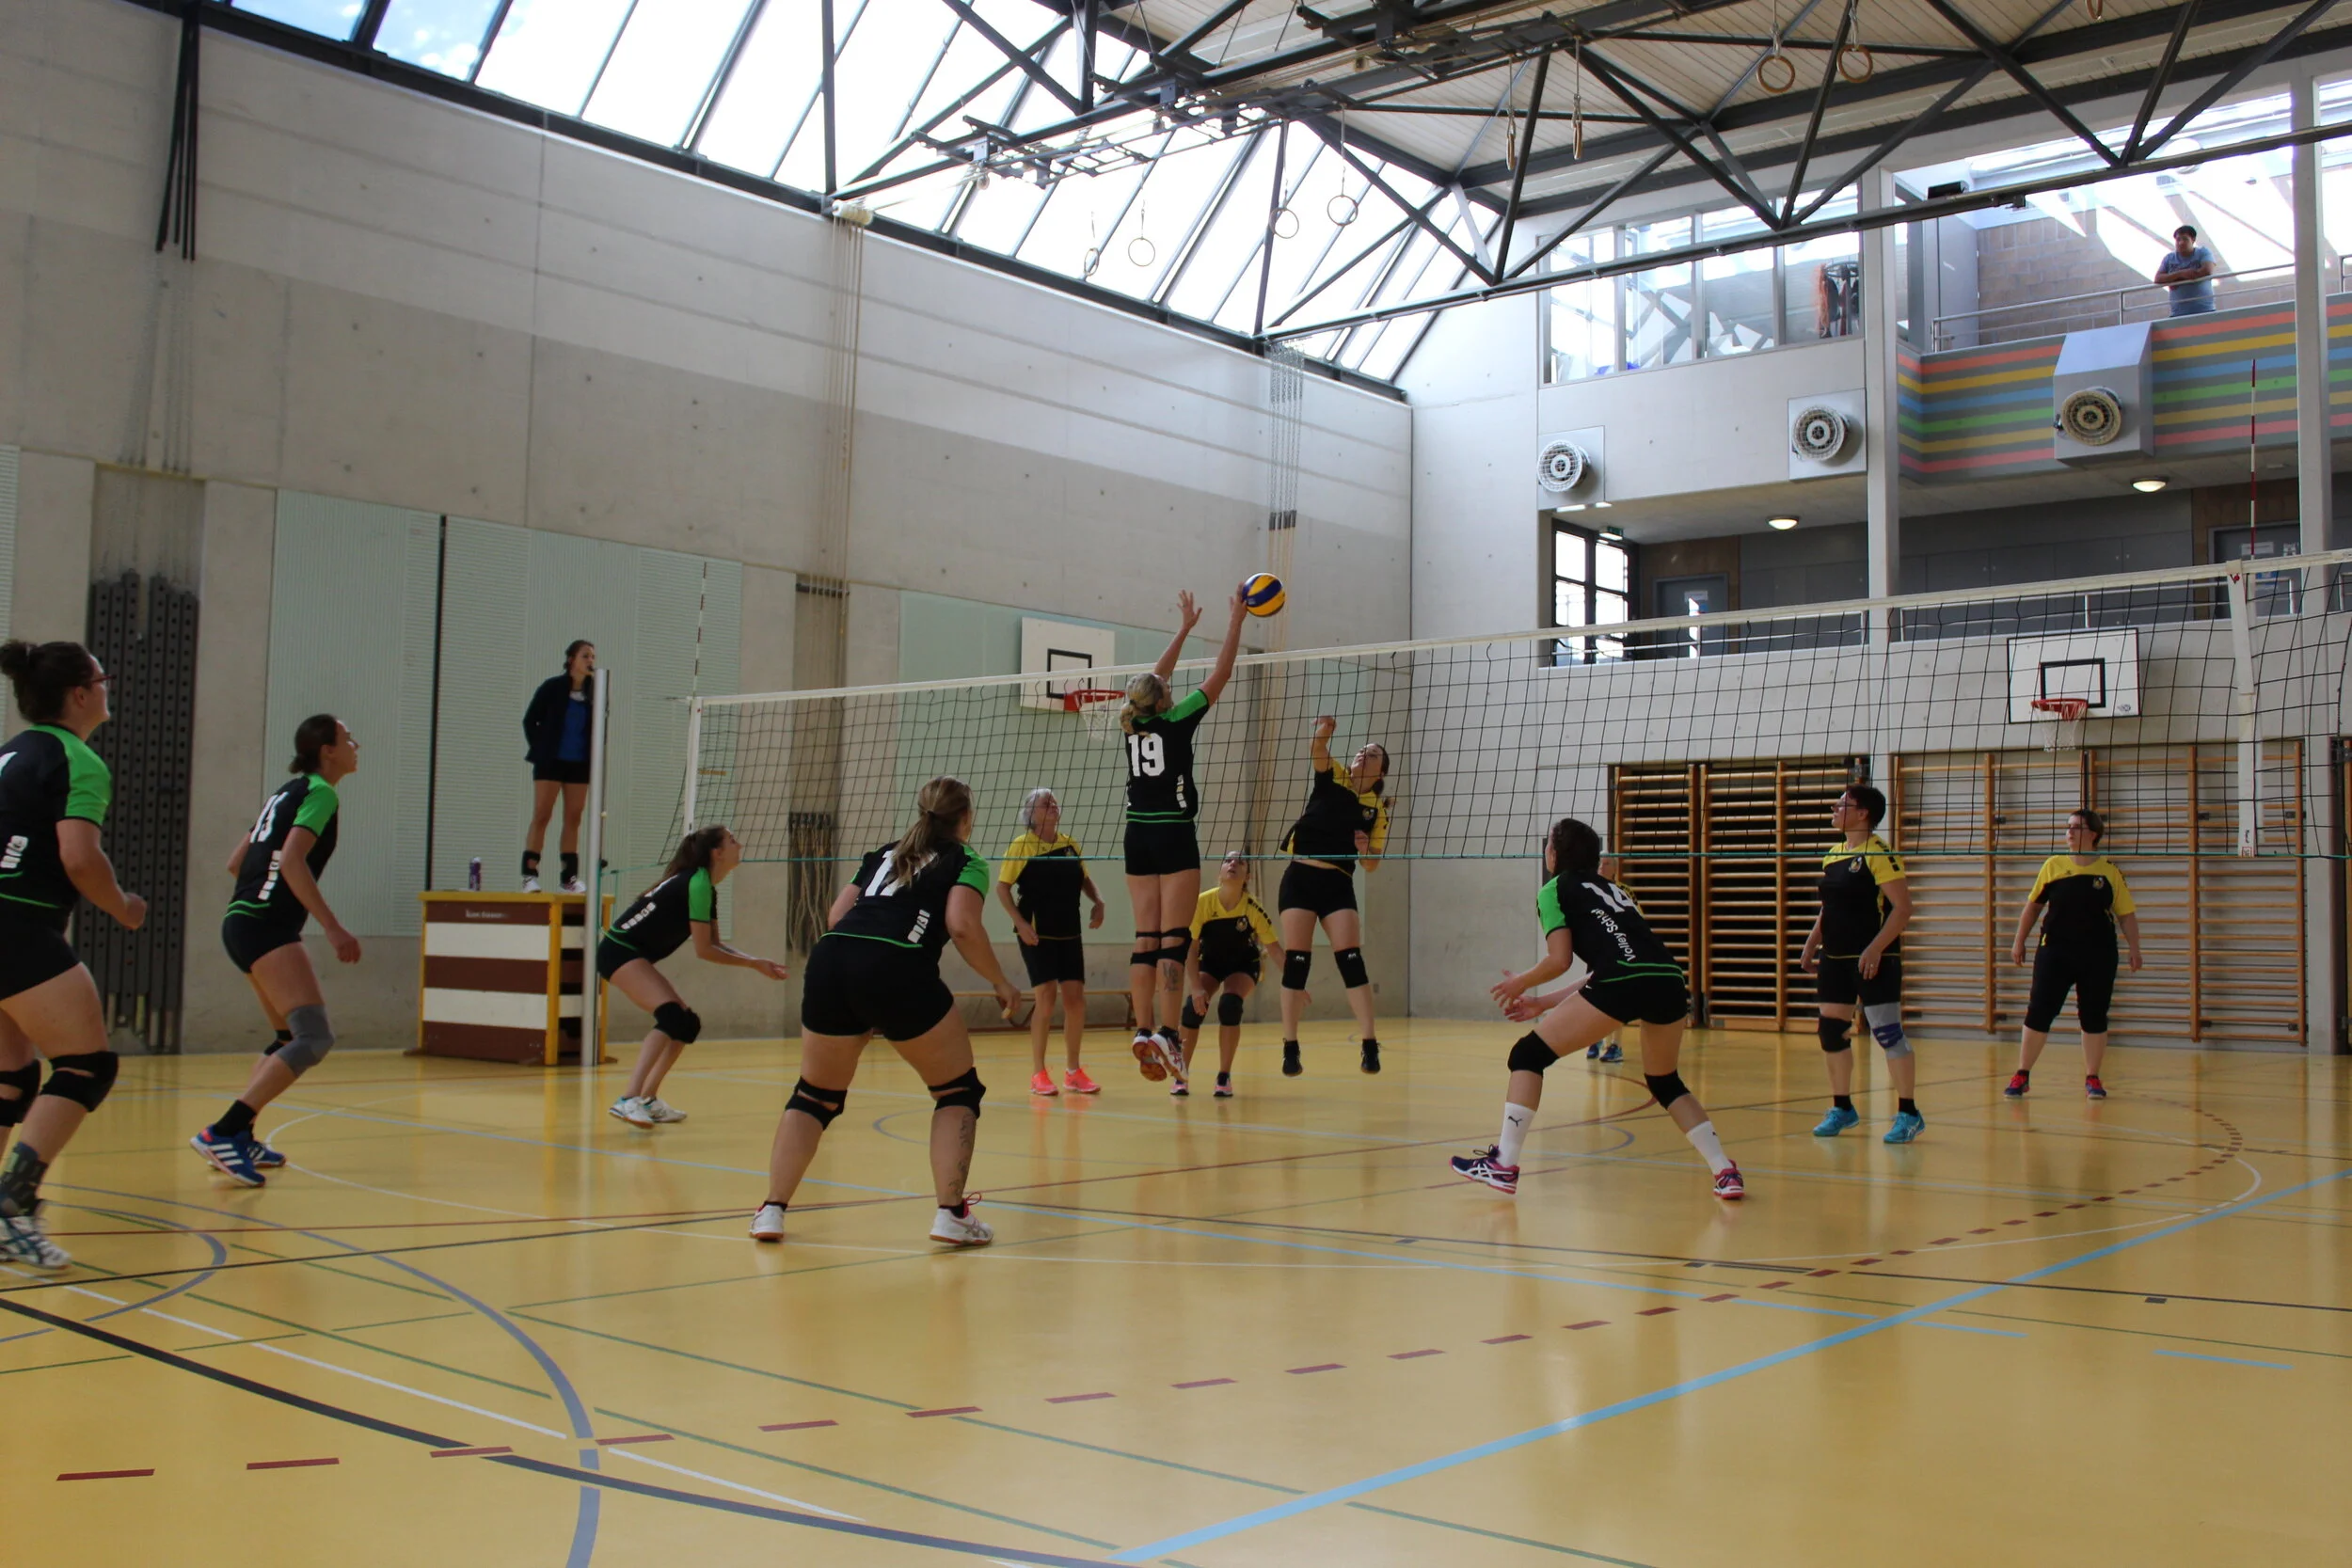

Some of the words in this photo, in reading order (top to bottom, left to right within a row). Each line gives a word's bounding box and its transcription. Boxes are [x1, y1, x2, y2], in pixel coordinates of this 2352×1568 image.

[1128, 733, 1165, 777] 19
[1581, 882, 1644, 917] 14
[1613, 932, 1636, 961] Volley
